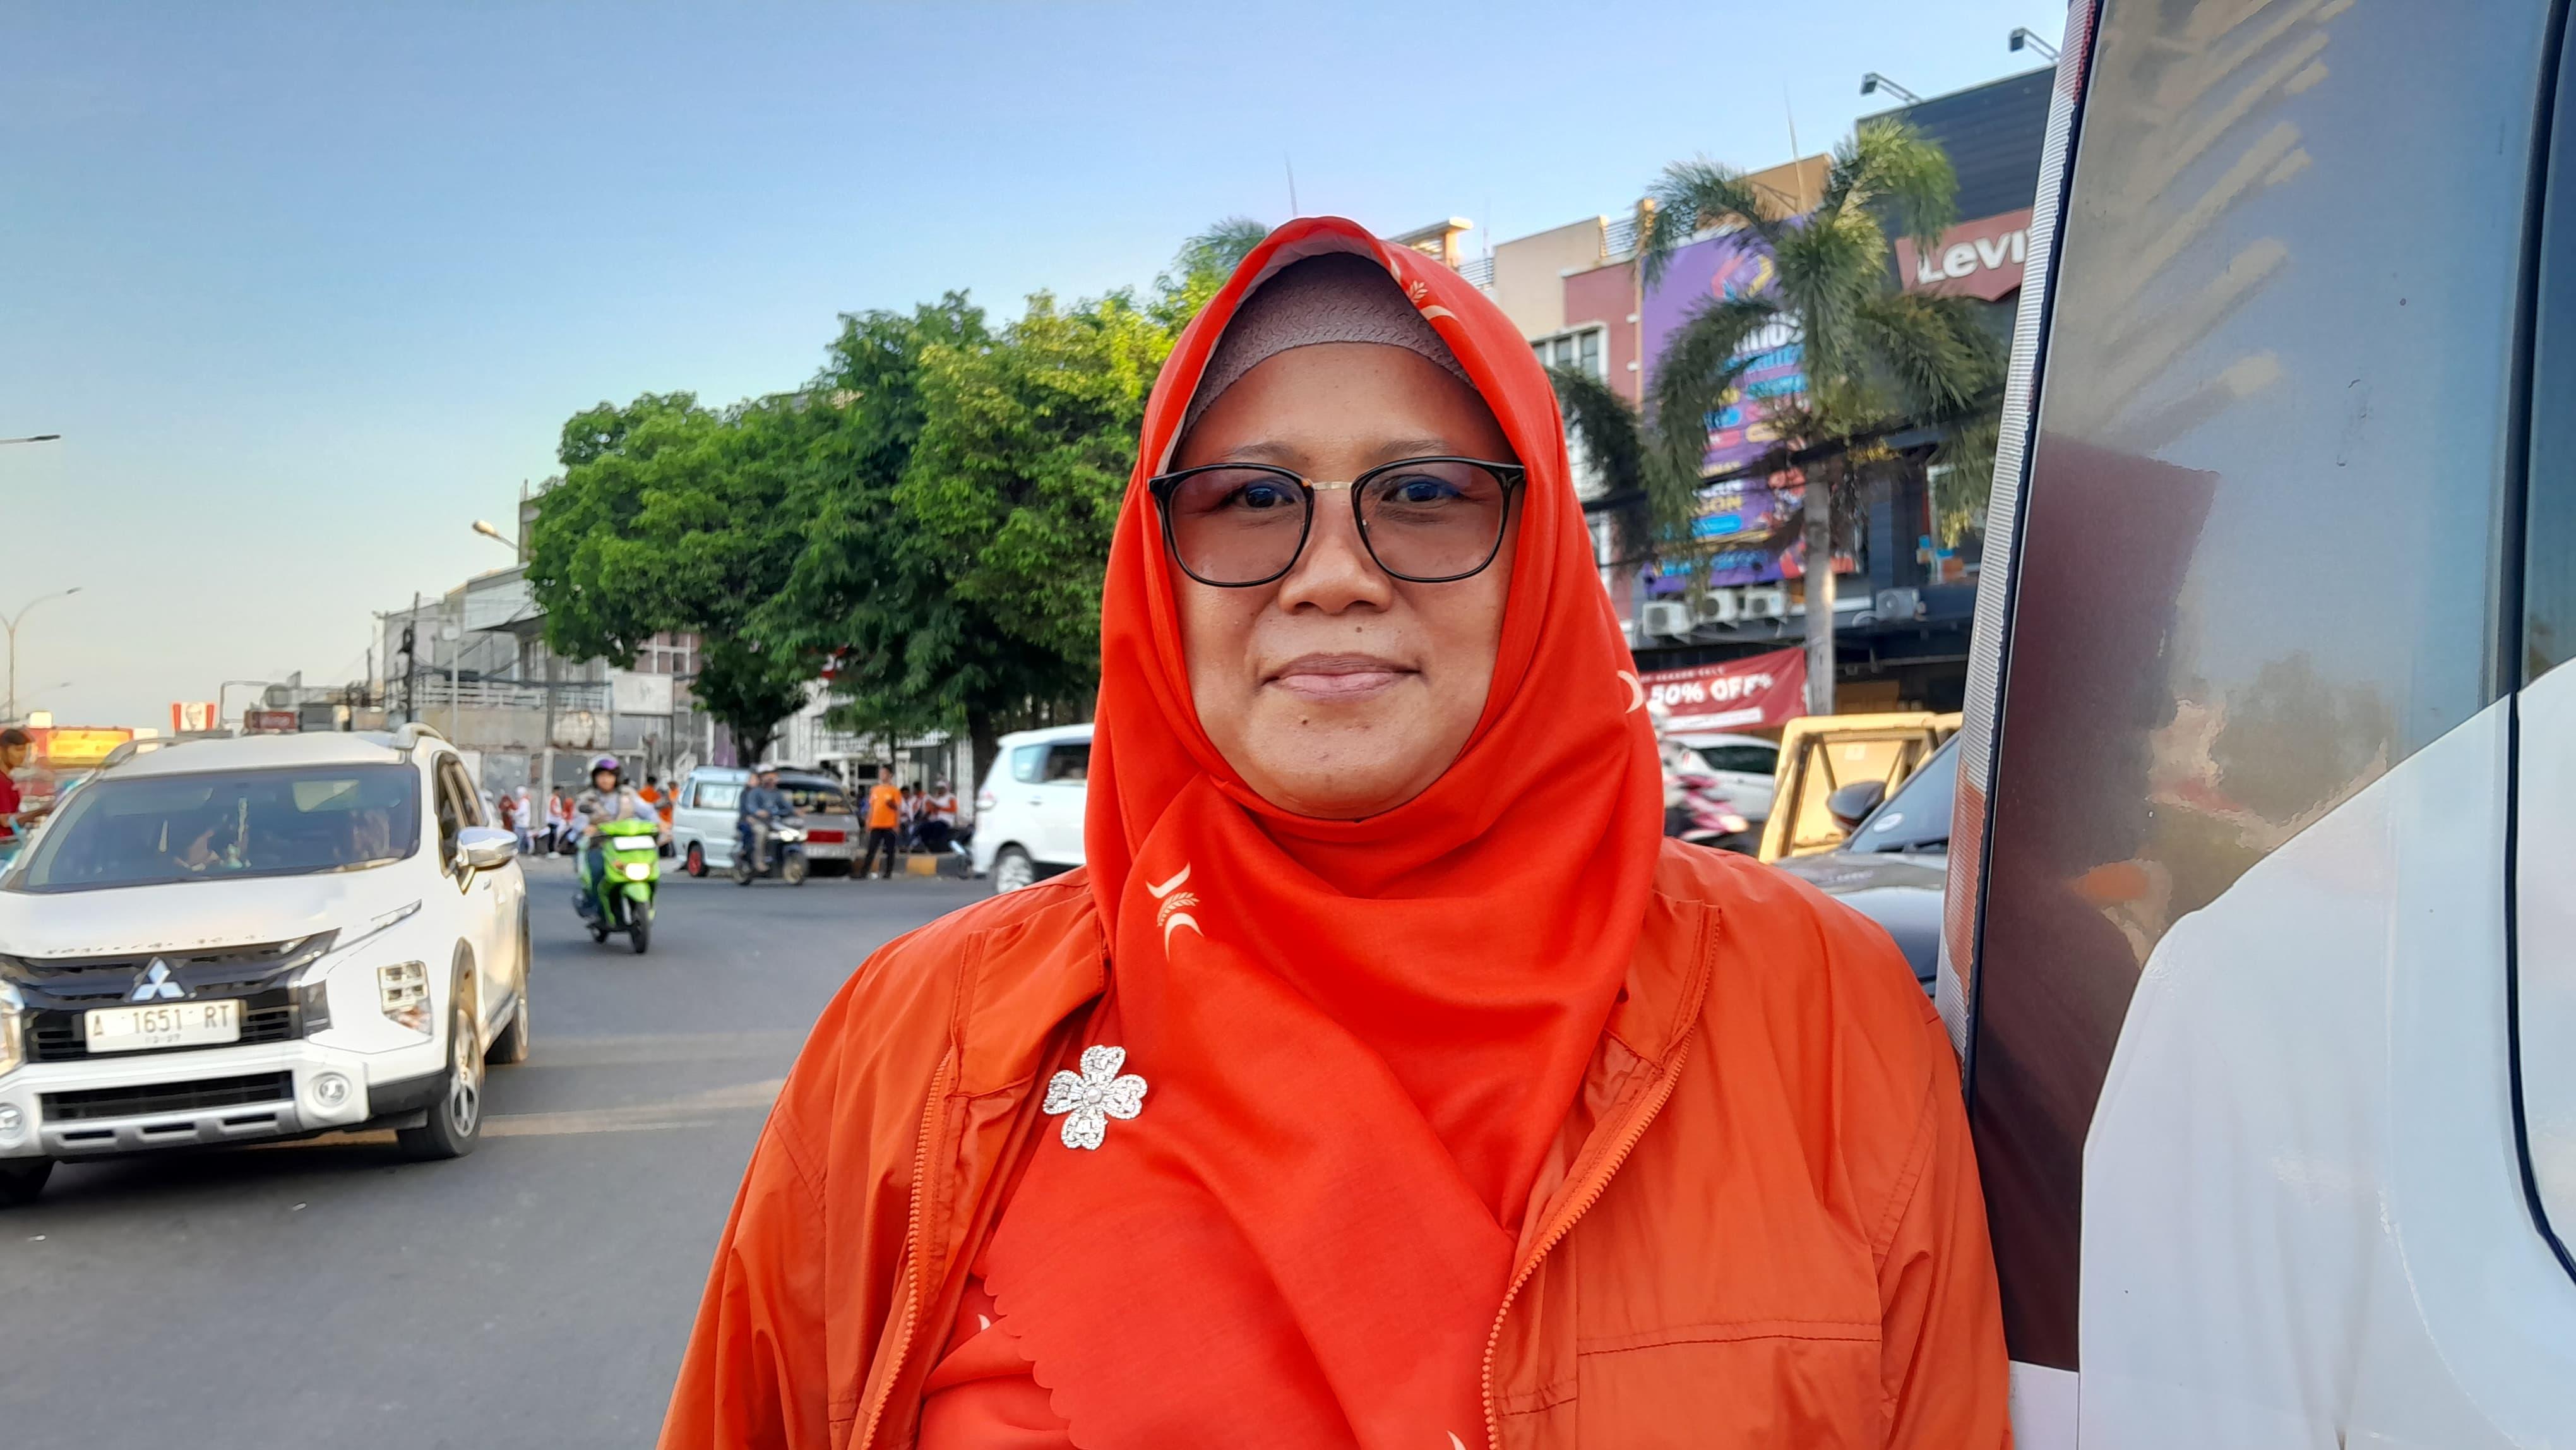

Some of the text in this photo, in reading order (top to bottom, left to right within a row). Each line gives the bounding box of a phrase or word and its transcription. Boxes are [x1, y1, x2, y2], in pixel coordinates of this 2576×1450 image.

[1650, 680, 1705, 705] 50%
[93, 1005, 229, 1036] A 1651 RT
